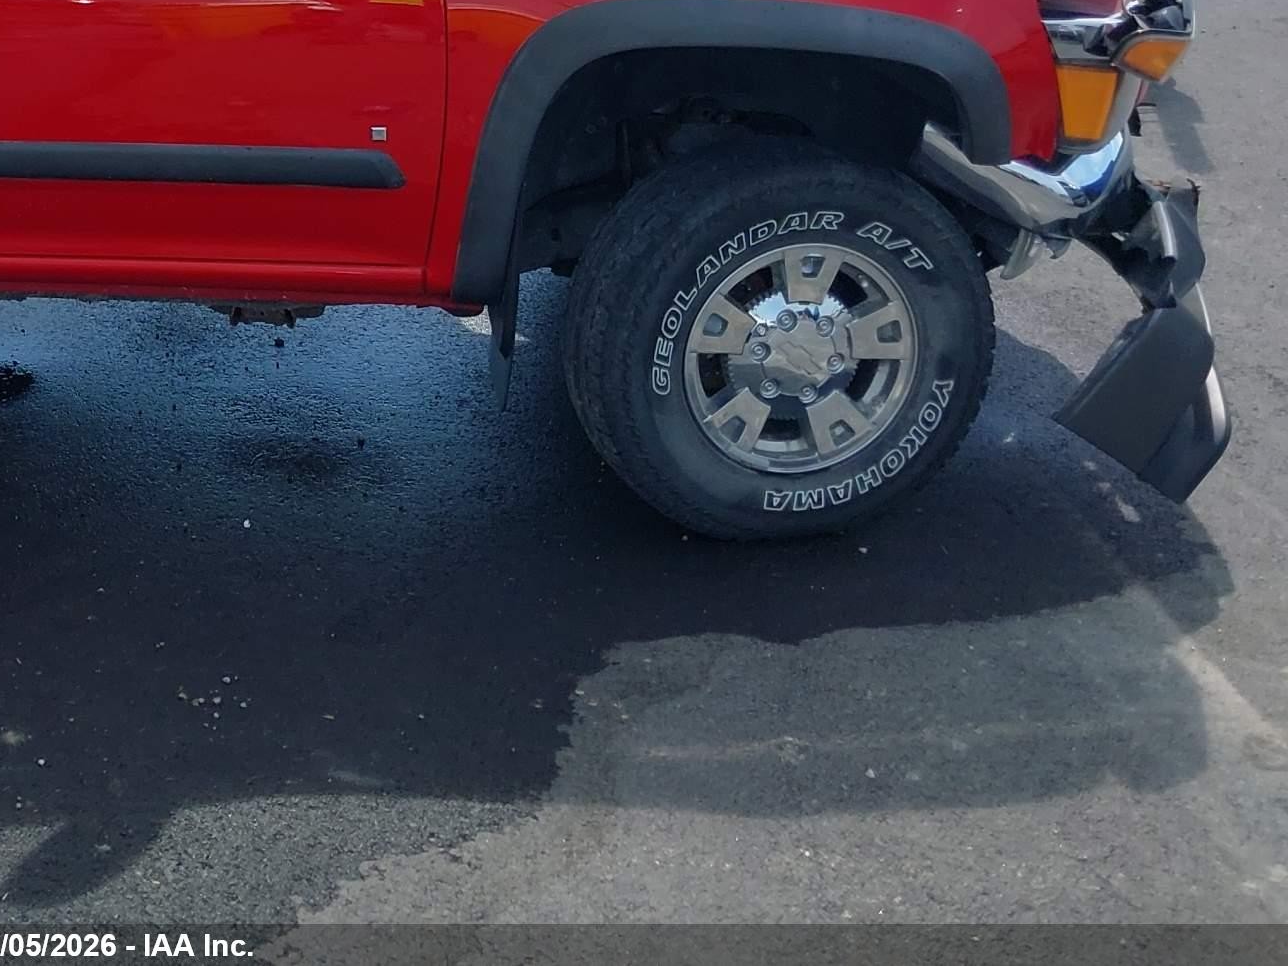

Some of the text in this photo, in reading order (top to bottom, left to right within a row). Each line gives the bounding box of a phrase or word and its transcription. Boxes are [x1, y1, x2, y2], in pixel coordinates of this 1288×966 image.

[652, 210, 933, 396] GEOLANDAR A/T
[763, 378, 954, 512] YOKOHAMA
